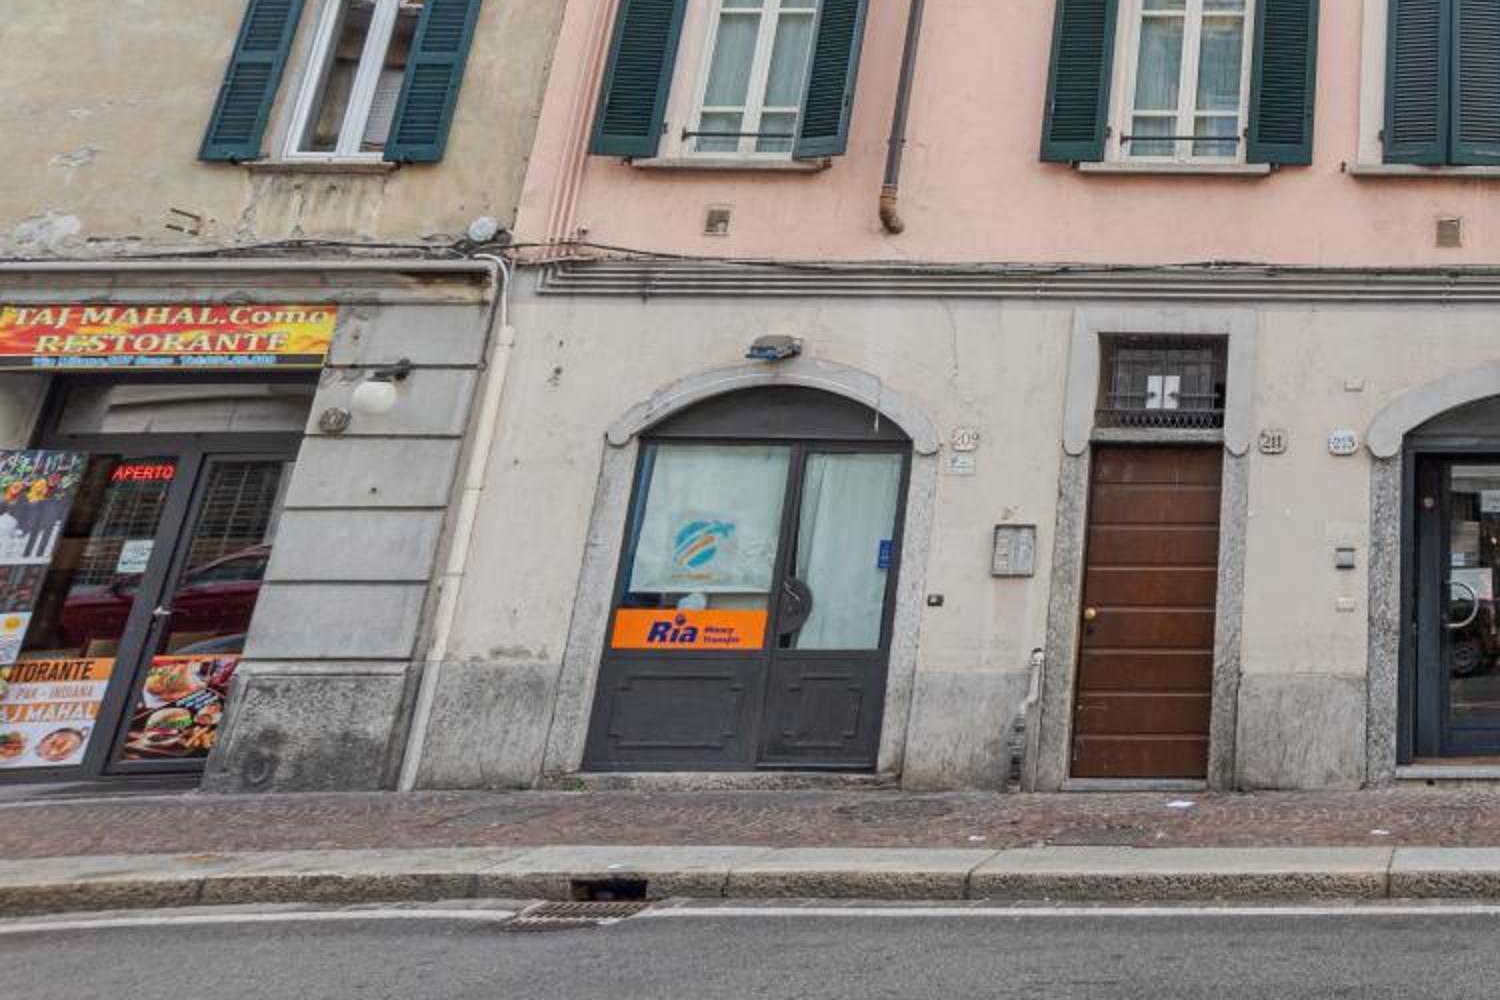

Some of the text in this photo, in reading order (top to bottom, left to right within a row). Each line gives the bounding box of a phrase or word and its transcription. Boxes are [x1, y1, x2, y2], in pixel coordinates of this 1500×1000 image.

[15, 306, 69, 328] TAJ
[112, 464, 176, 480] APERTO
[647, 614, 698, 642] Ria
[29, 701, 97, 721] MAHAL
